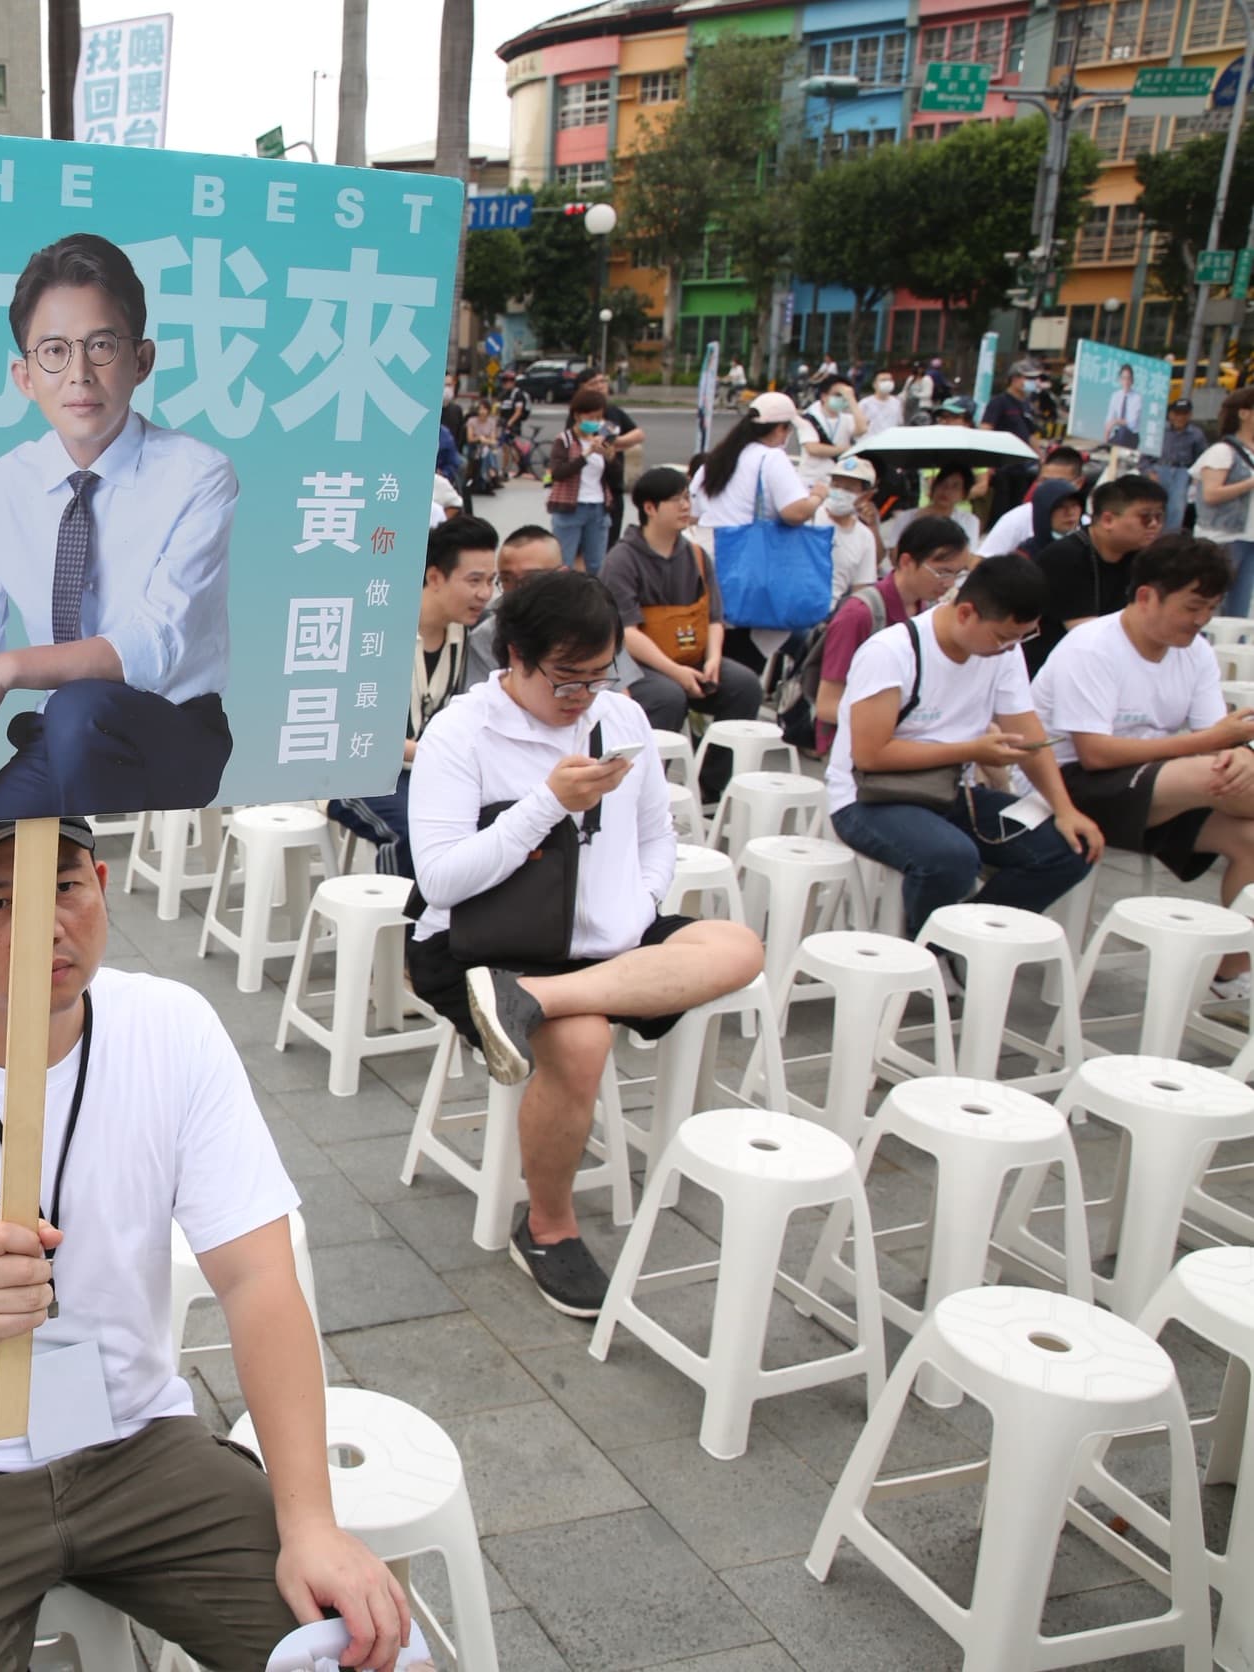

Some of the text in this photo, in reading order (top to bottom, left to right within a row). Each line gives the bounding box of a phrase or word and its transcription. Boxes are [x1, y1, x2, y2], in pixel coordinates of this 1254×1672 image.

[192, 175, 433, 235] BEST
[278, 471, 366, 764] 黃國昌
[349, 473, 399, 759] 為你做到最好
